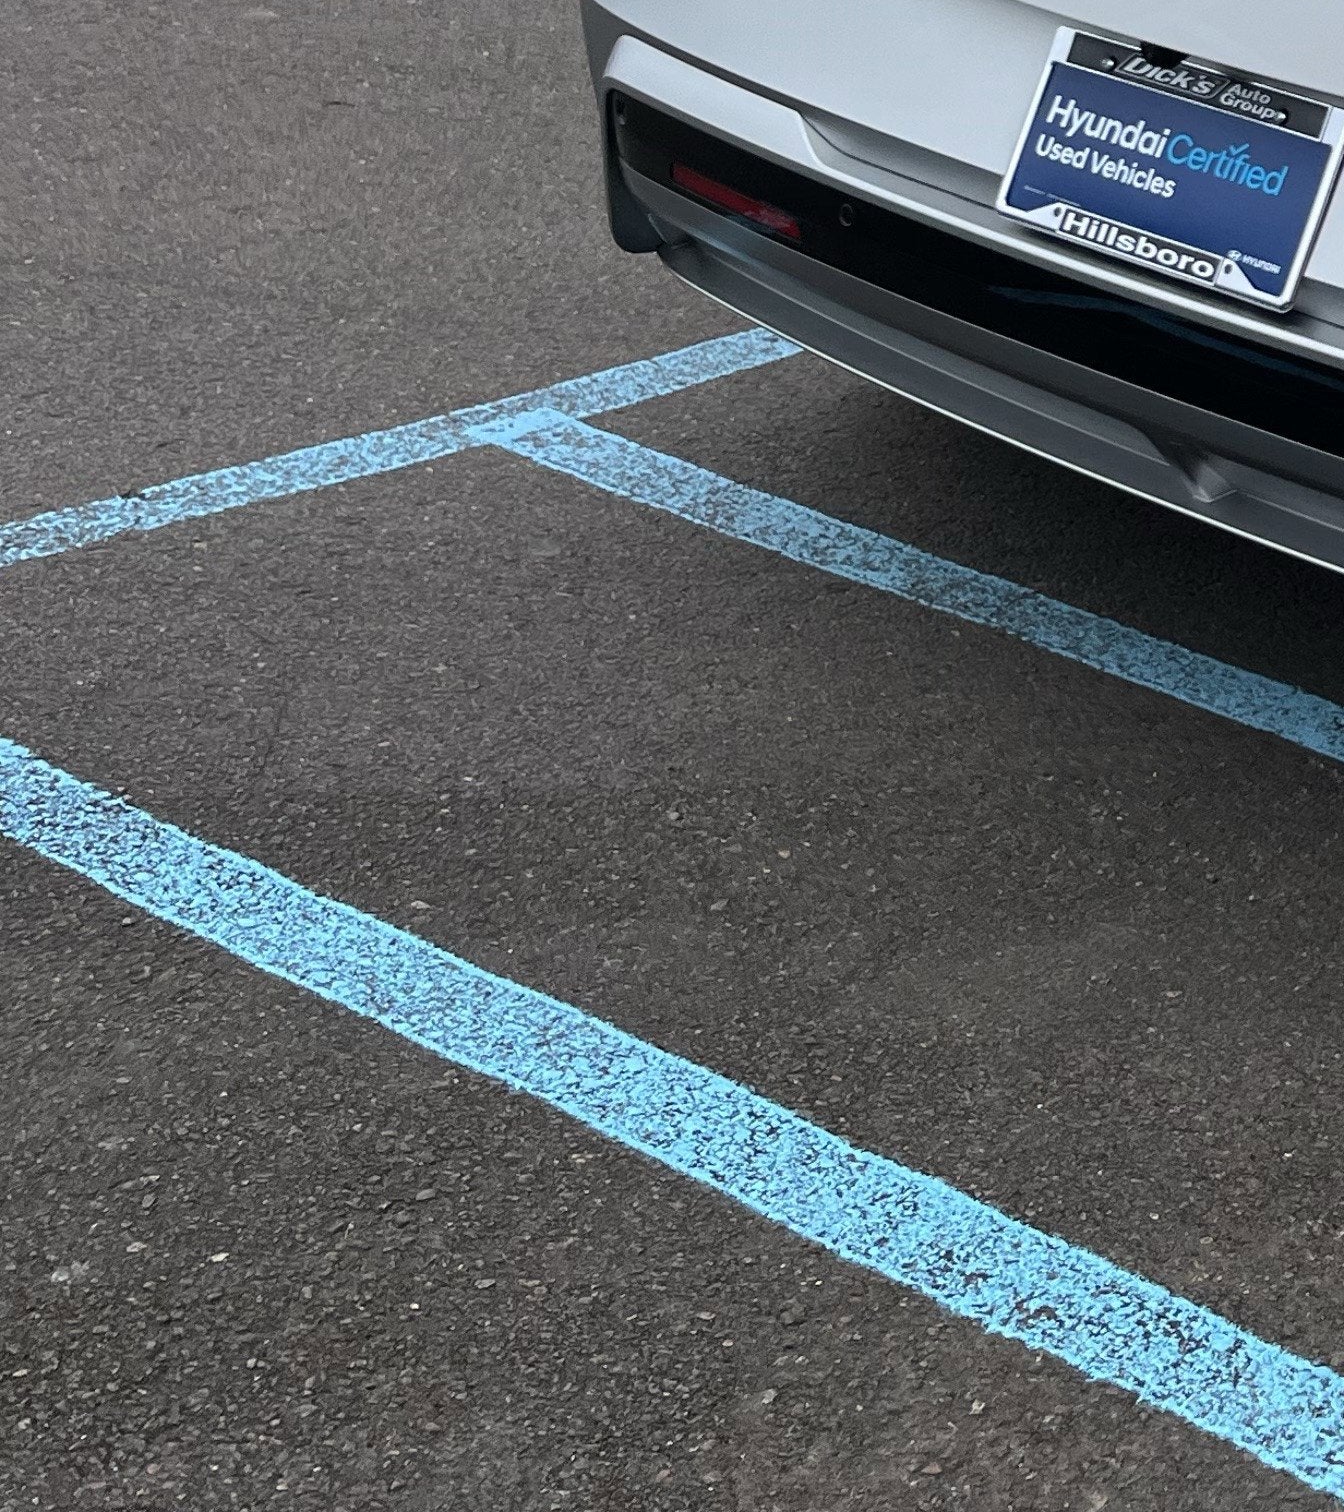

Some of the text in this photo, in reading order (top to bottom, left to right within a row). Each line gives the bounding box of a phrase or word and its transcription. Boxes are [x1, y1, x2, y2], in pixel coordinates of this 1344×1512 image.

[1219, 93, 1281, 124] Group
[1227, 82, 1272, 105] Auto
[1035, 133, 1091, 170] Used
[1091, 150, 1177, 198] Vehicles
[1045, 94, 1289, 196] Hyundai Certified
[1062, 211, 1215, 278] Hillsboro
